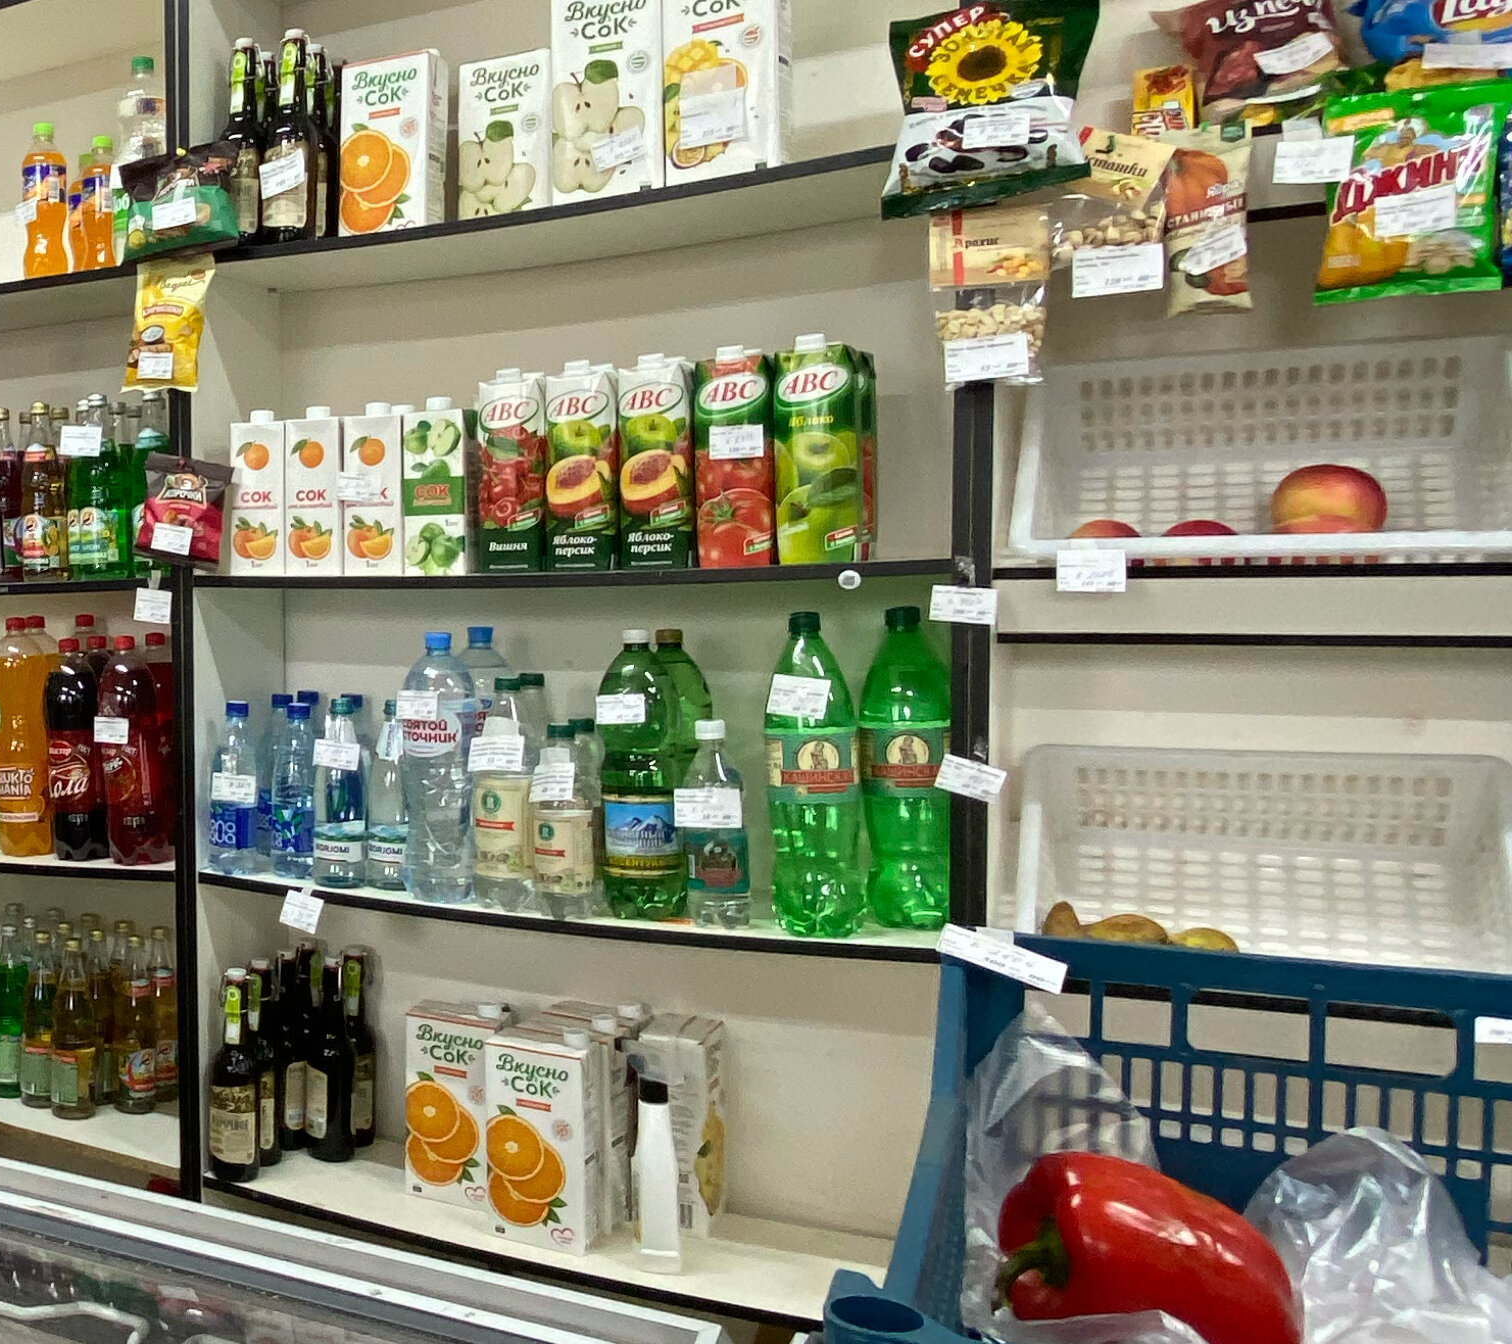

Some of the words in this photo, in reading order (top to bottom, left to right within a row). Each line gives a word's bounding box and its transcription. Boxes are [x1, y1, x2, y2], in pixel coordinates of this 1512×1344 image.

[908, 6, 985, 58] СУПЕР
[352, 64, 418, 93] Вкусно
[471, 62, 540, 91] Вкусно
[705, 378, 757, 401] ABC
[782, 369, 839, 393] ABC
[549, 396, 599, 417] ABC
[623, 388, 674, 411] ABC
[485, 402, 529, 423] ABC
[241, 490, 272, 504] СОК
[296, 489, 327, 502] СОК
[489, 540, 528, 553] Вишня
[555, 544, 595, 557] персик
[630, 541, 672, 556] персик
[416, 1023, 484, 1051] Вкусно
[495, 1053, 569, 1082] Вкусно
